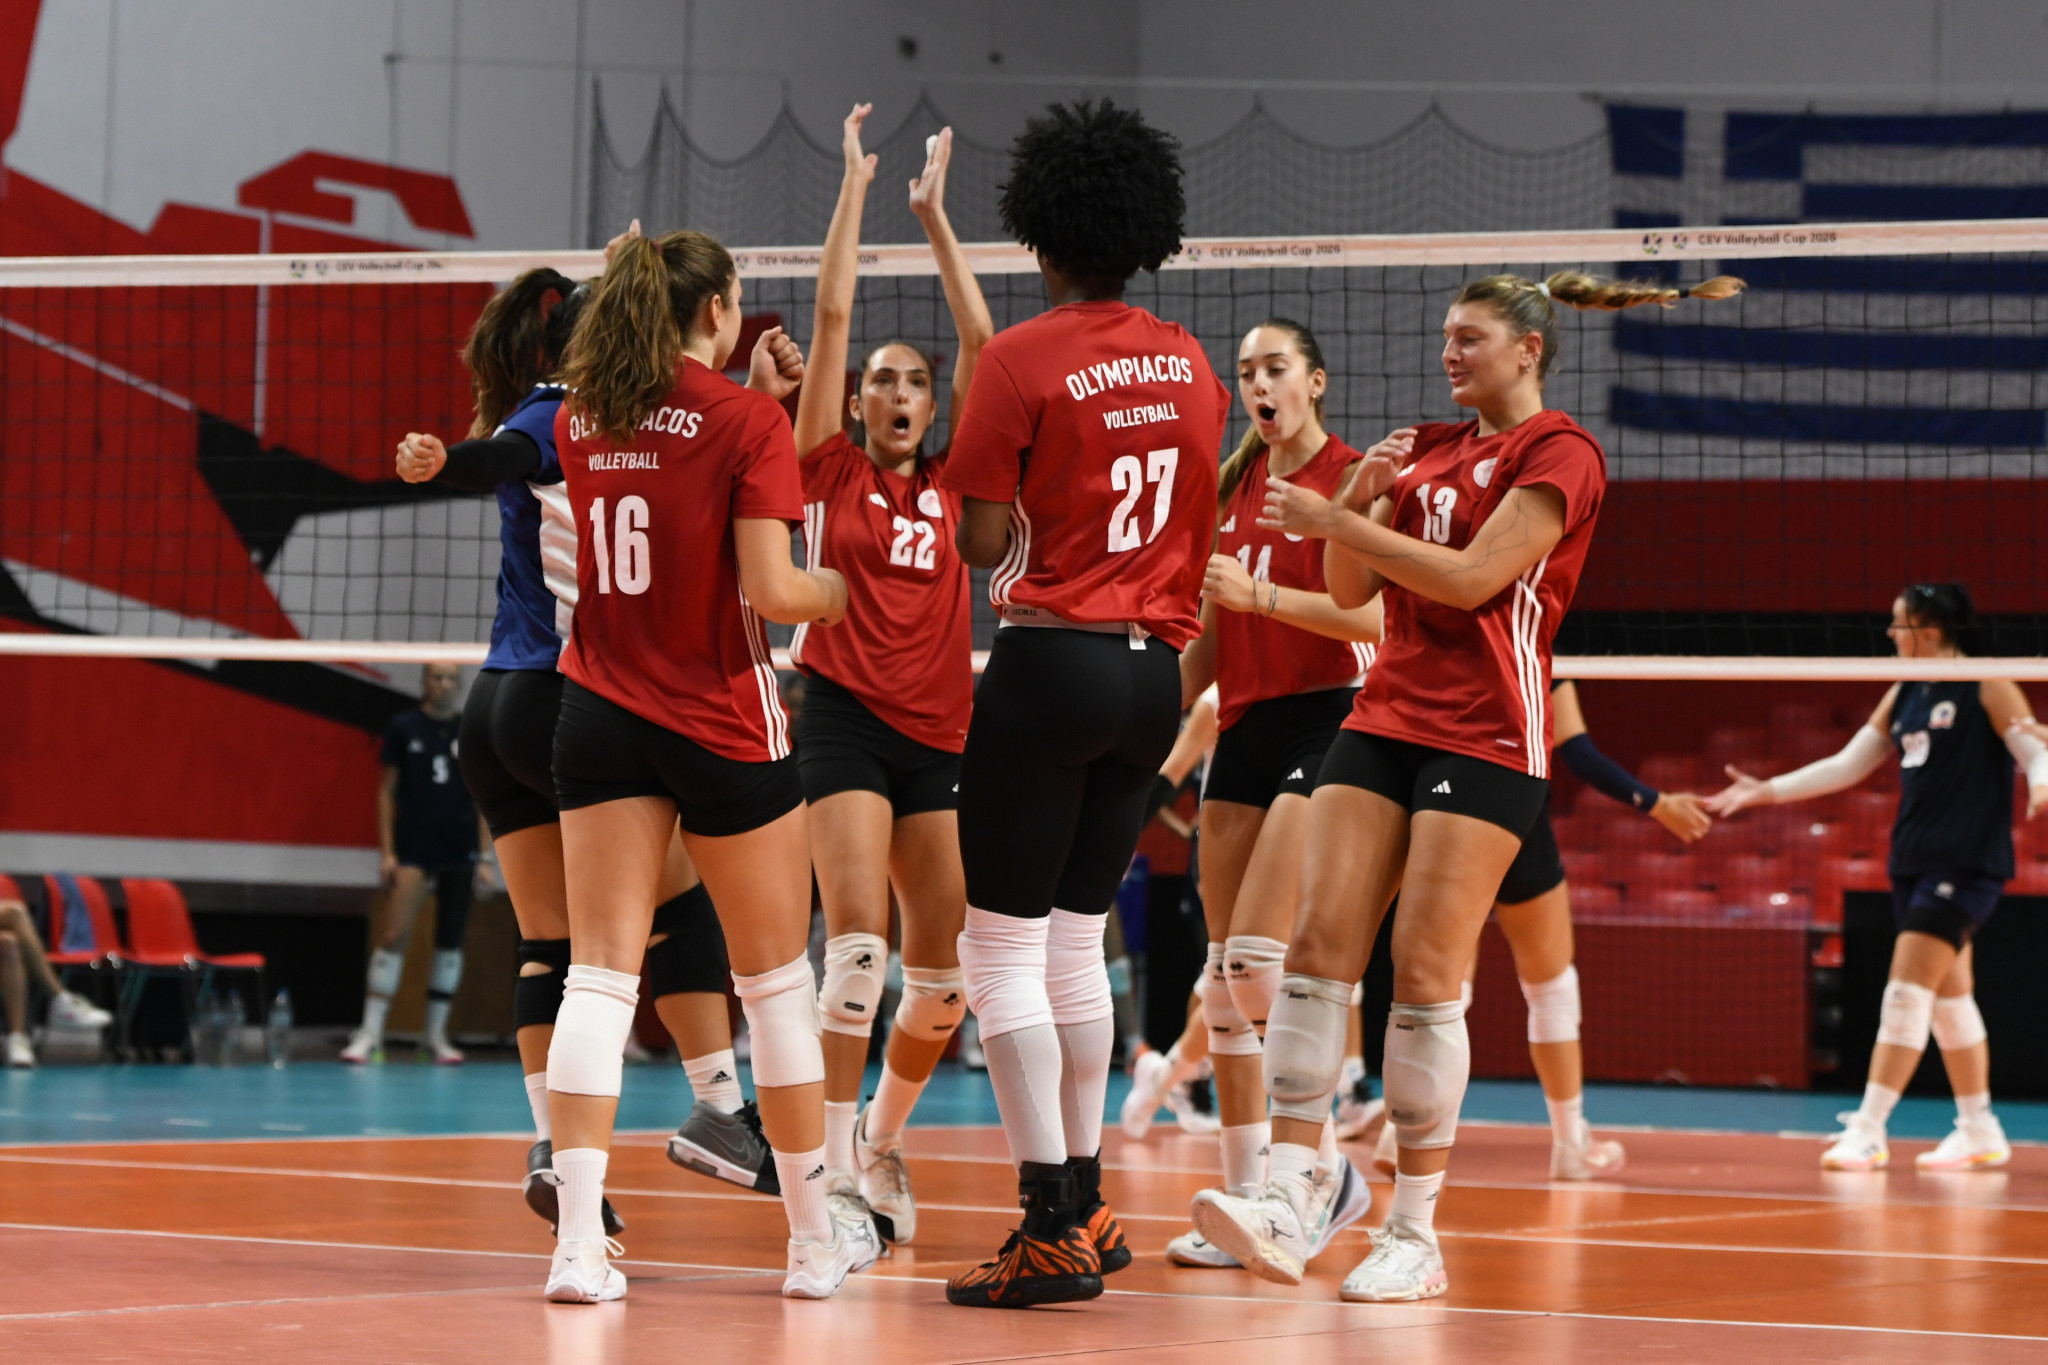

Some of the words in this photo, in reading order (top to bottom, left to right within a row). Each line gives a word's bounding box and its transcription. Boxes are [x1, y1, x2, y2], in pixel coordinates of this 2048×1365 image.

[1211, 247, 1232, 258] CEV
[1235, 245, 1287, 258] Volleyball
[1290, 245, 1312, 256] Cup
[1698, 233, 1720, 246] CEV
[1724, 232, 1779, 246] Volleyball
[1783, 233, 1806, 245] Cup
[756, 255, 777, 266] CEV
[1065, 354, 1193, 401] OLYMPIACOS
[1103, 402, 1179, 430] VOLLEYBALL
[588, 452, 660, 472] VOLLEYBALL
[1107, 447, 1179, 553] 27
[1416, 483, 1458, 544] 13
[589, 495, 651, 596] 16
[889, 515, 937, 570] 22
